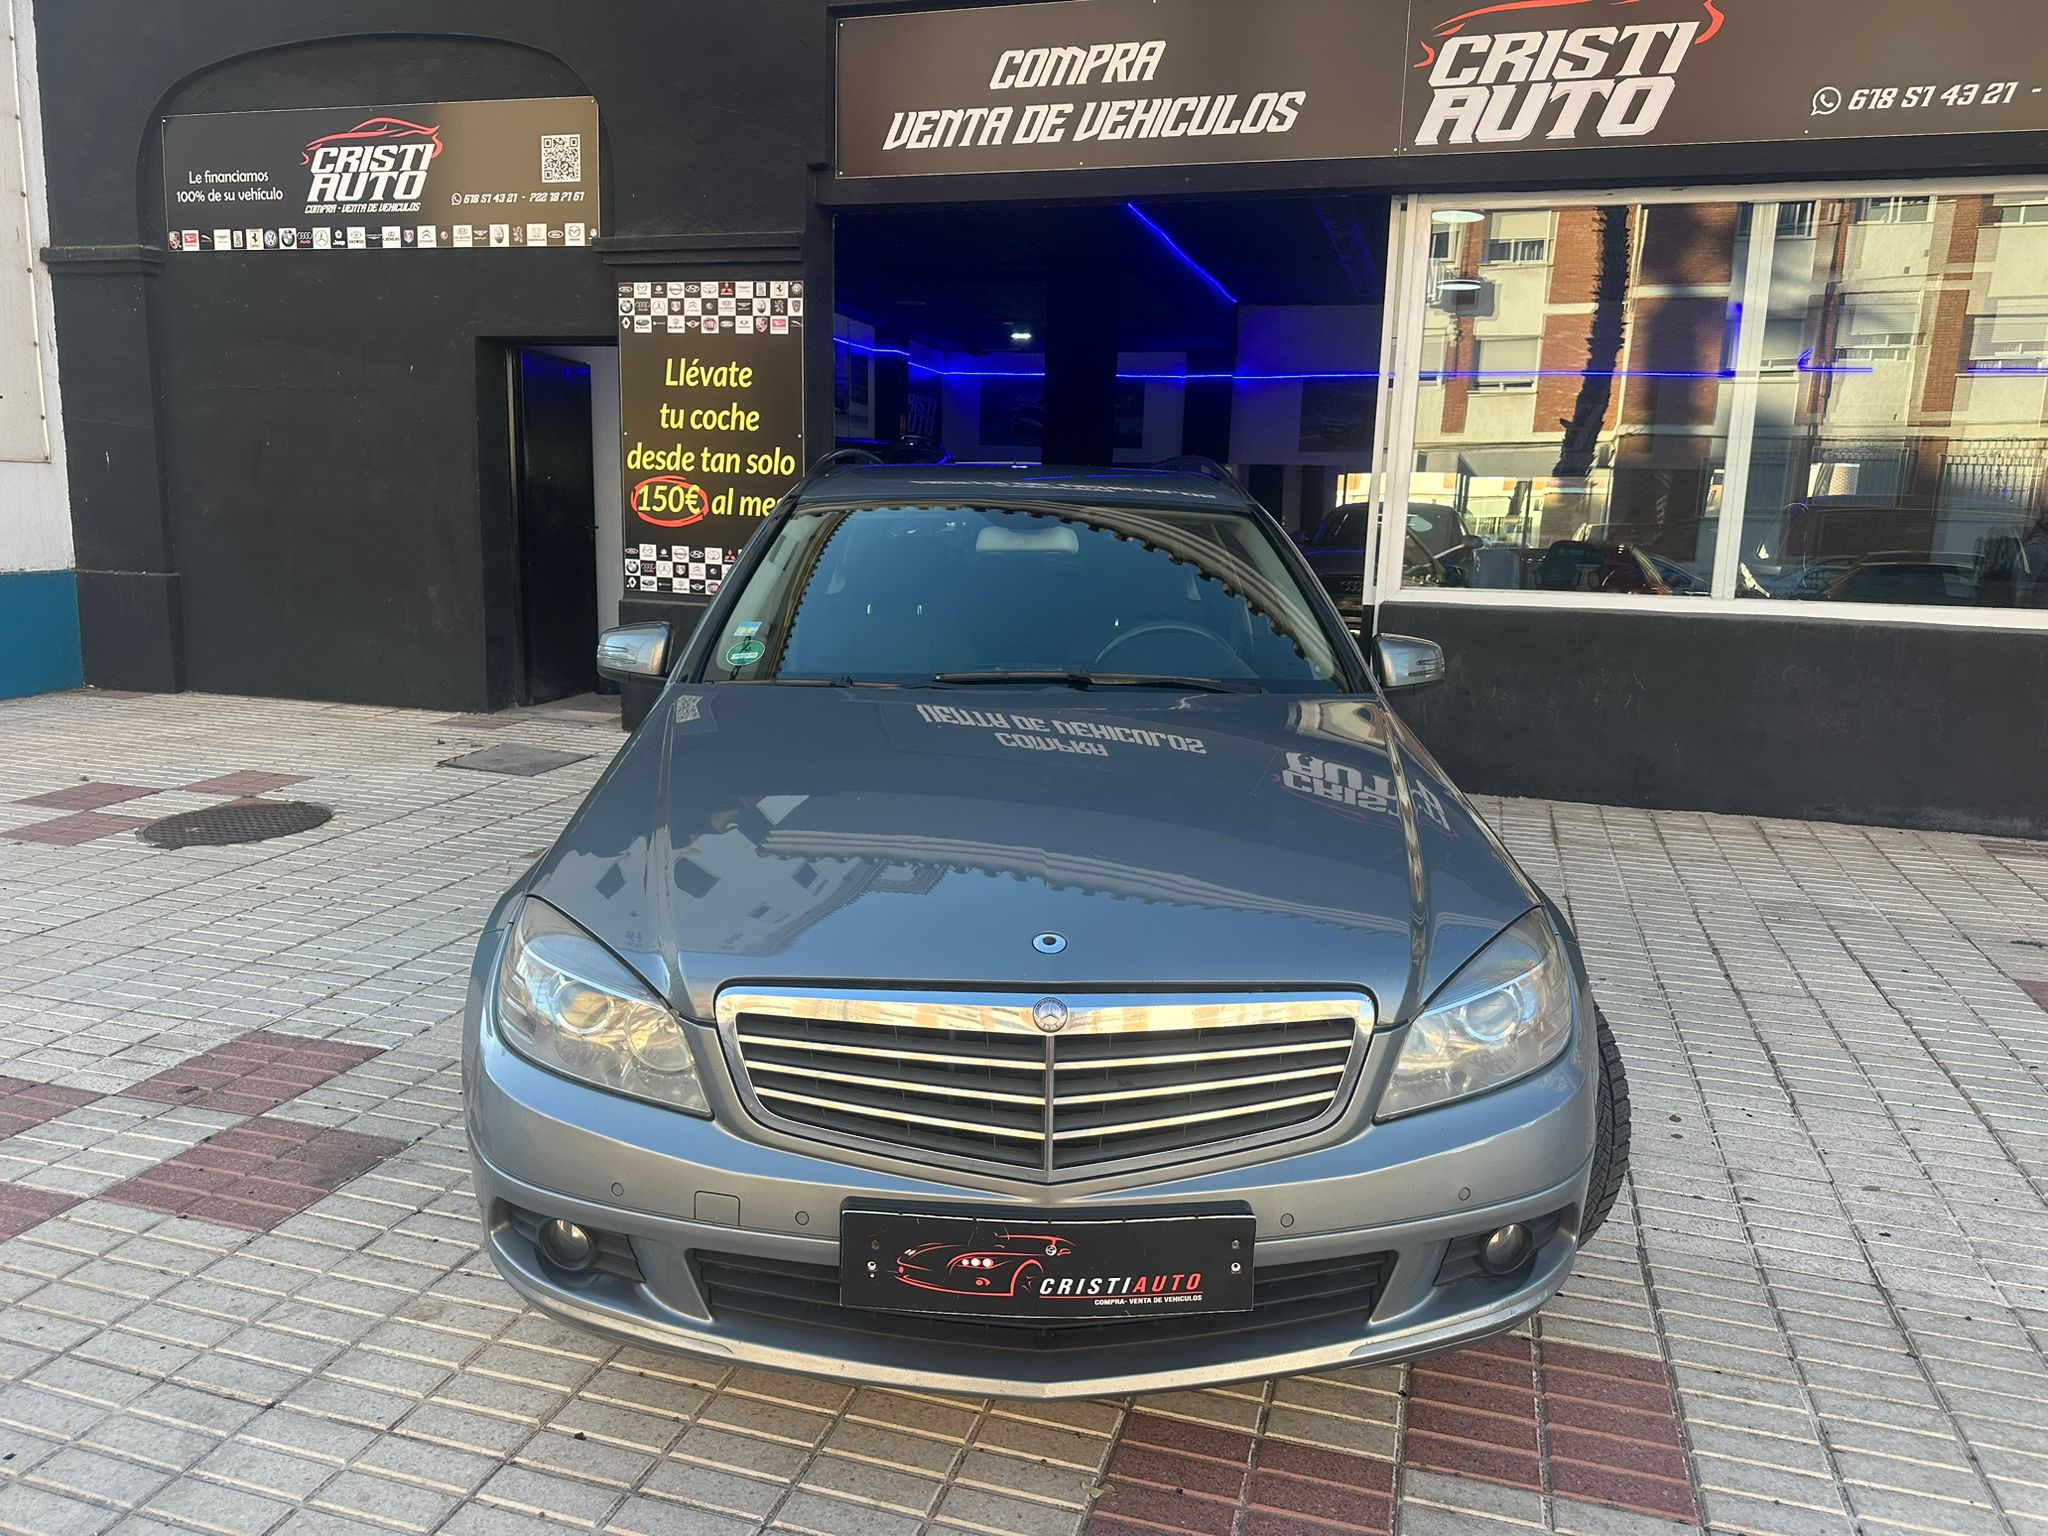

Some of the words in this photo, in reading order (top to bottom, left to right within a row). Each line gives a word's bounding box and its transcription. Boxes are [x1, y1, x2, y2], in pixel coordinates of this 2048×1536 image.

[989, 40, 1166, 90] COMPRA
[1428, 21, 1700, 87] CRISTI
[1940, 83, 1980, 106] 43
[882, 106, 1013, 150] VENTA
[1011, 103, 1074, 145] DE
[1074, 91, 1307, 142] VEHICULOS
[1414, 75, 1676, 146] AUTO
[310, 144, 435, 174] CRISTI
[188, 170, 203, 185] Le
[204, 169, 269, 184] financiamos
[307, 170, 428, 202] AUTO
[176, 190, 206, 203] 100%
[207, 188, 222, 202] de
[223, 191, 236, 202] su
[237, 186, 284, 201] vehículo
[304, 203, 337, 214] COMPRA
[341, 203, 368, 213] VENTA
[367, 203, 379, 212] DE
[378, 202, 421, 212] VEHICULOS
[665, 357, 753, 388] Llévate
[660, 402, 685, 430] tu
[689, 402, 761, 432] coche
[908, 392, 937, 418] RISTI
[907, 412, 935, 436] UTO
[626, 442, 695, 472] desde
[701, 446, 741, 474] tan
[745, 446, 796, 476] solo
[637, 484, 702, 515] 150€
[711, 487, 734, 516] al
[739, 496, 783, 517] me
[1039, 1273, 1202, 1295] CRISTIAUTO
[1129, 1297, 1152, 1305] VENTA
[1164, 1294, 1203, 1303] VEHICULOS
